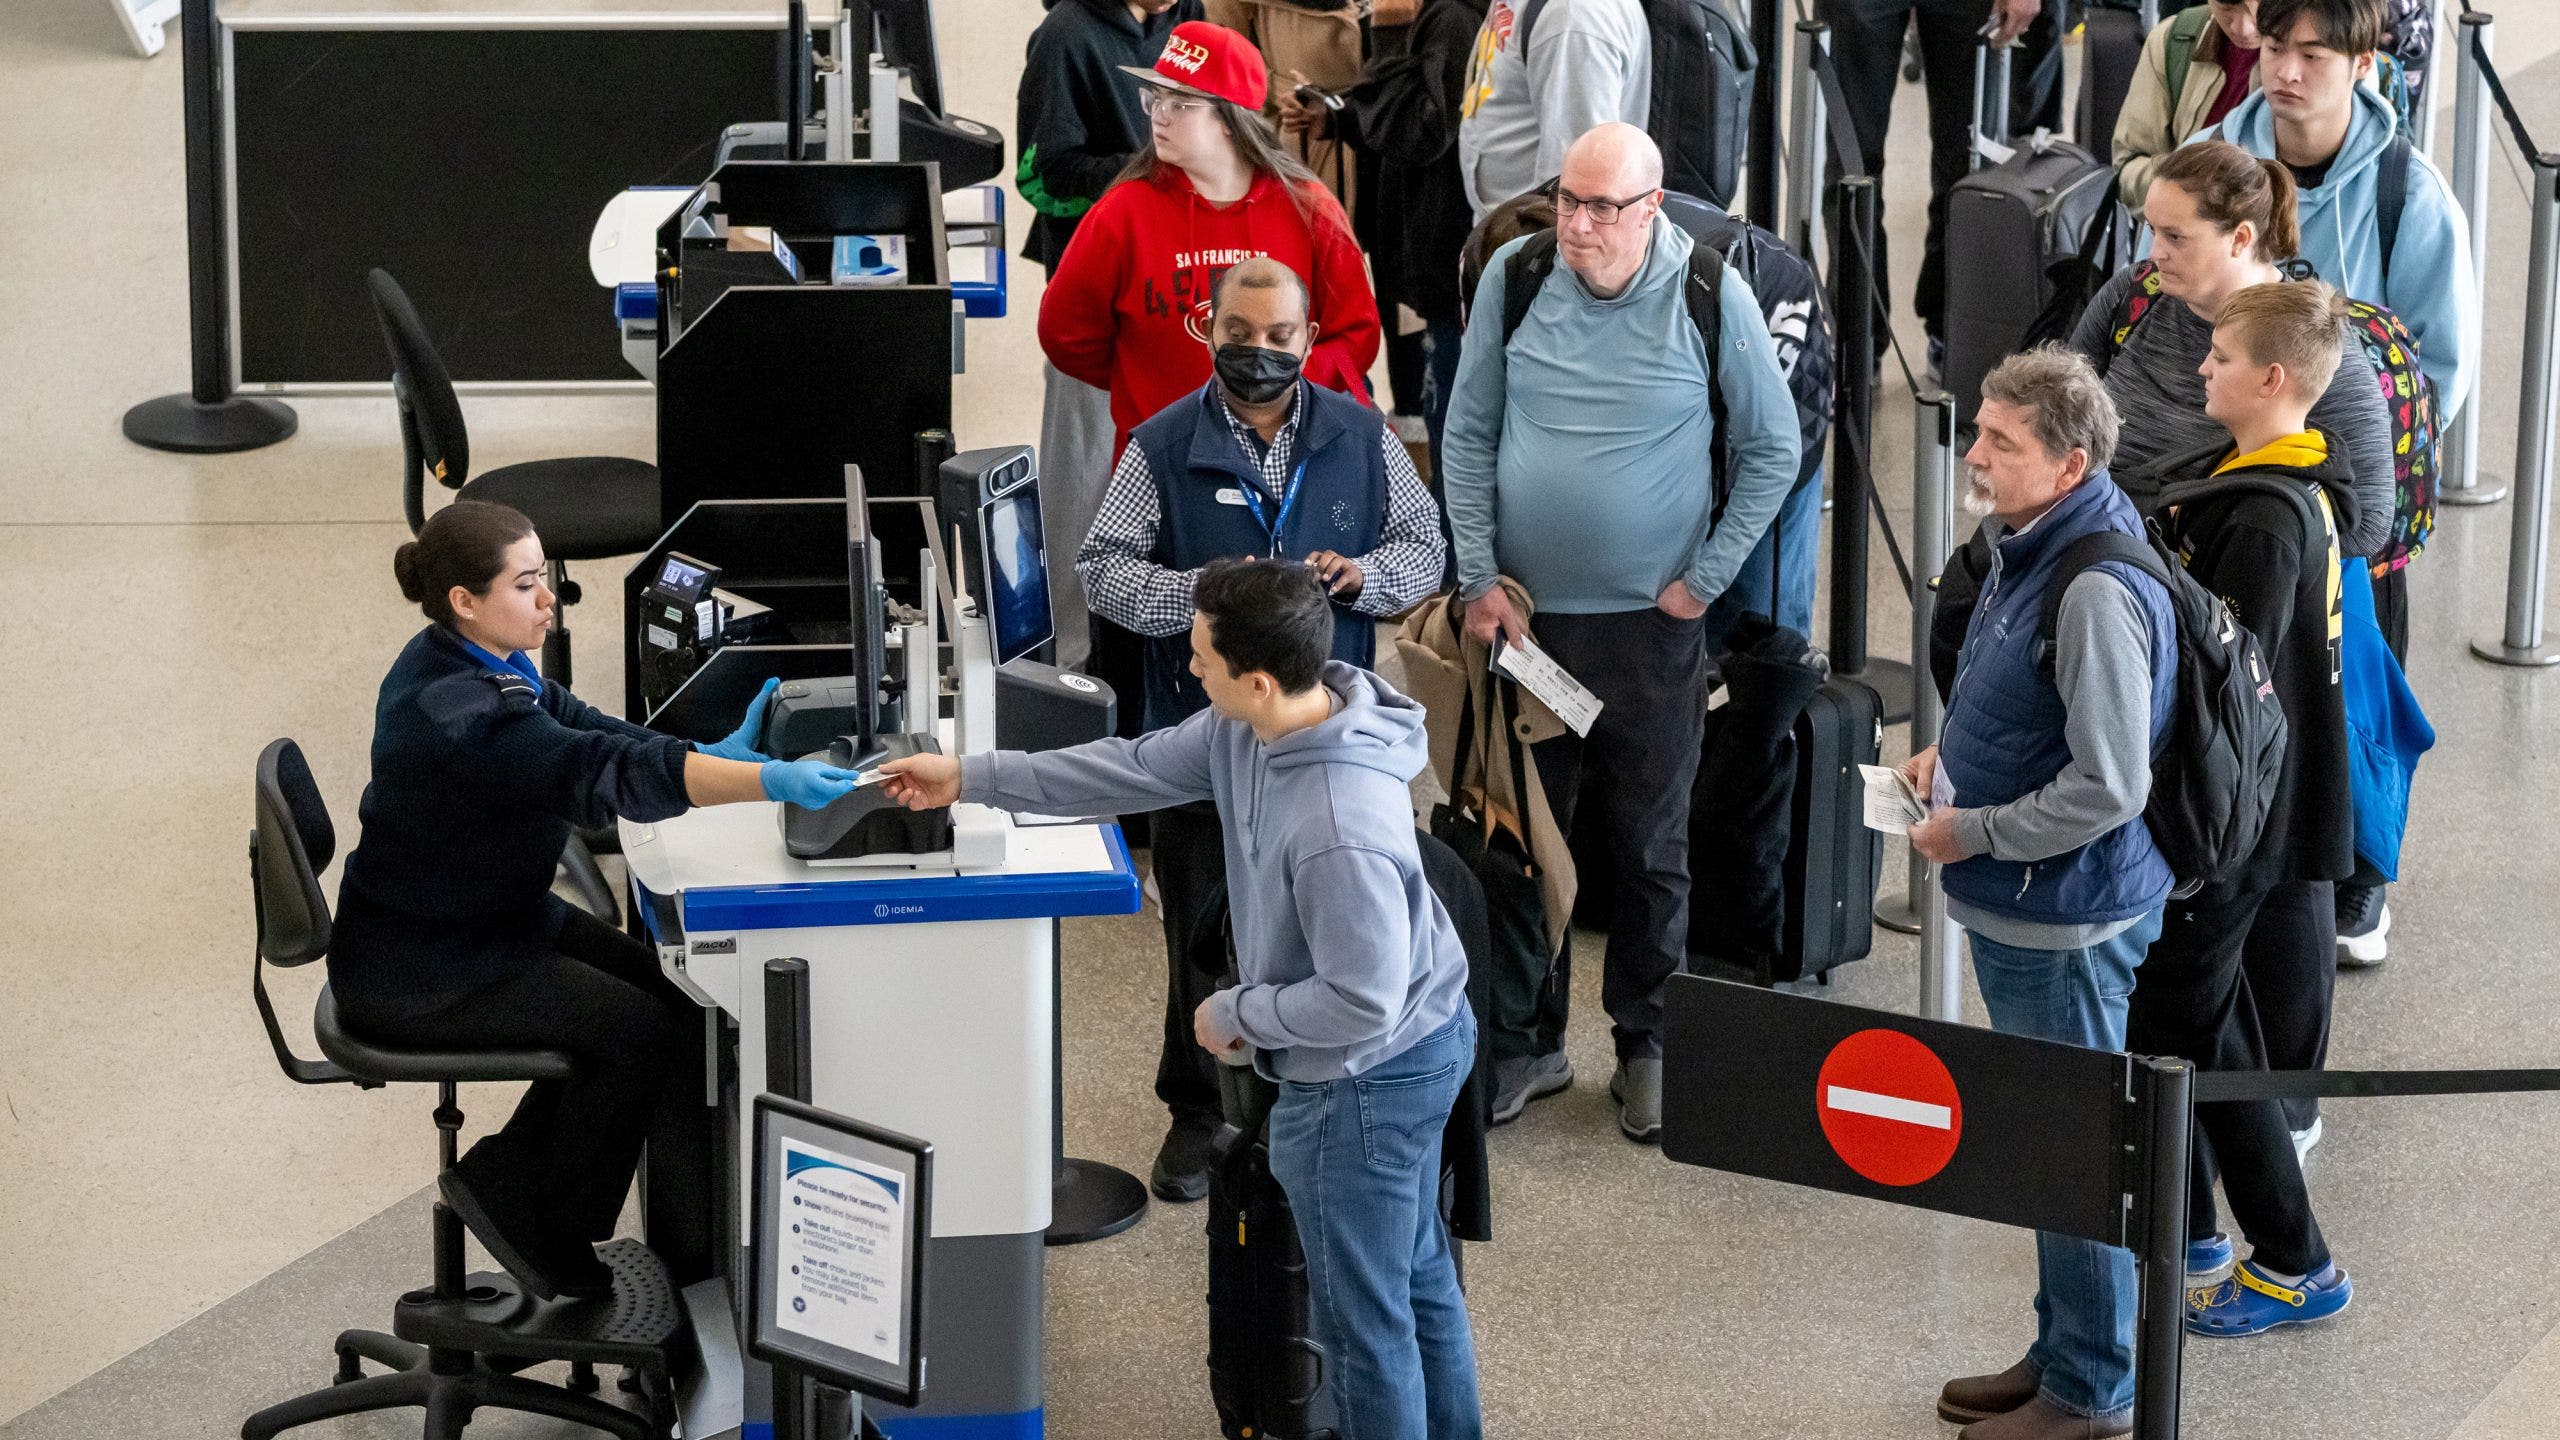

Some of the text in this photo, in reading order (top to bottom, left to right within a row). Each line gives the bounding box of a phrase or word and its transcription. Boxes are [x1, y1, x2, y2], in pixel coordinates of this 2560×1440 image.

[891, 904, 924, 914] IDEMIA
[797, 1179, 818, 1192] Please
[819, 1186, 827, 1194] be
[828, 1189, 847, 1201] ready
[849, 1195, 858, 1204] for
[803, 1199, 821, 1211] Show
[803, 1218, 818, 1229] Take
[819, 1224, 830, 1232] out
[802, 1255, 817, 1266] Take
